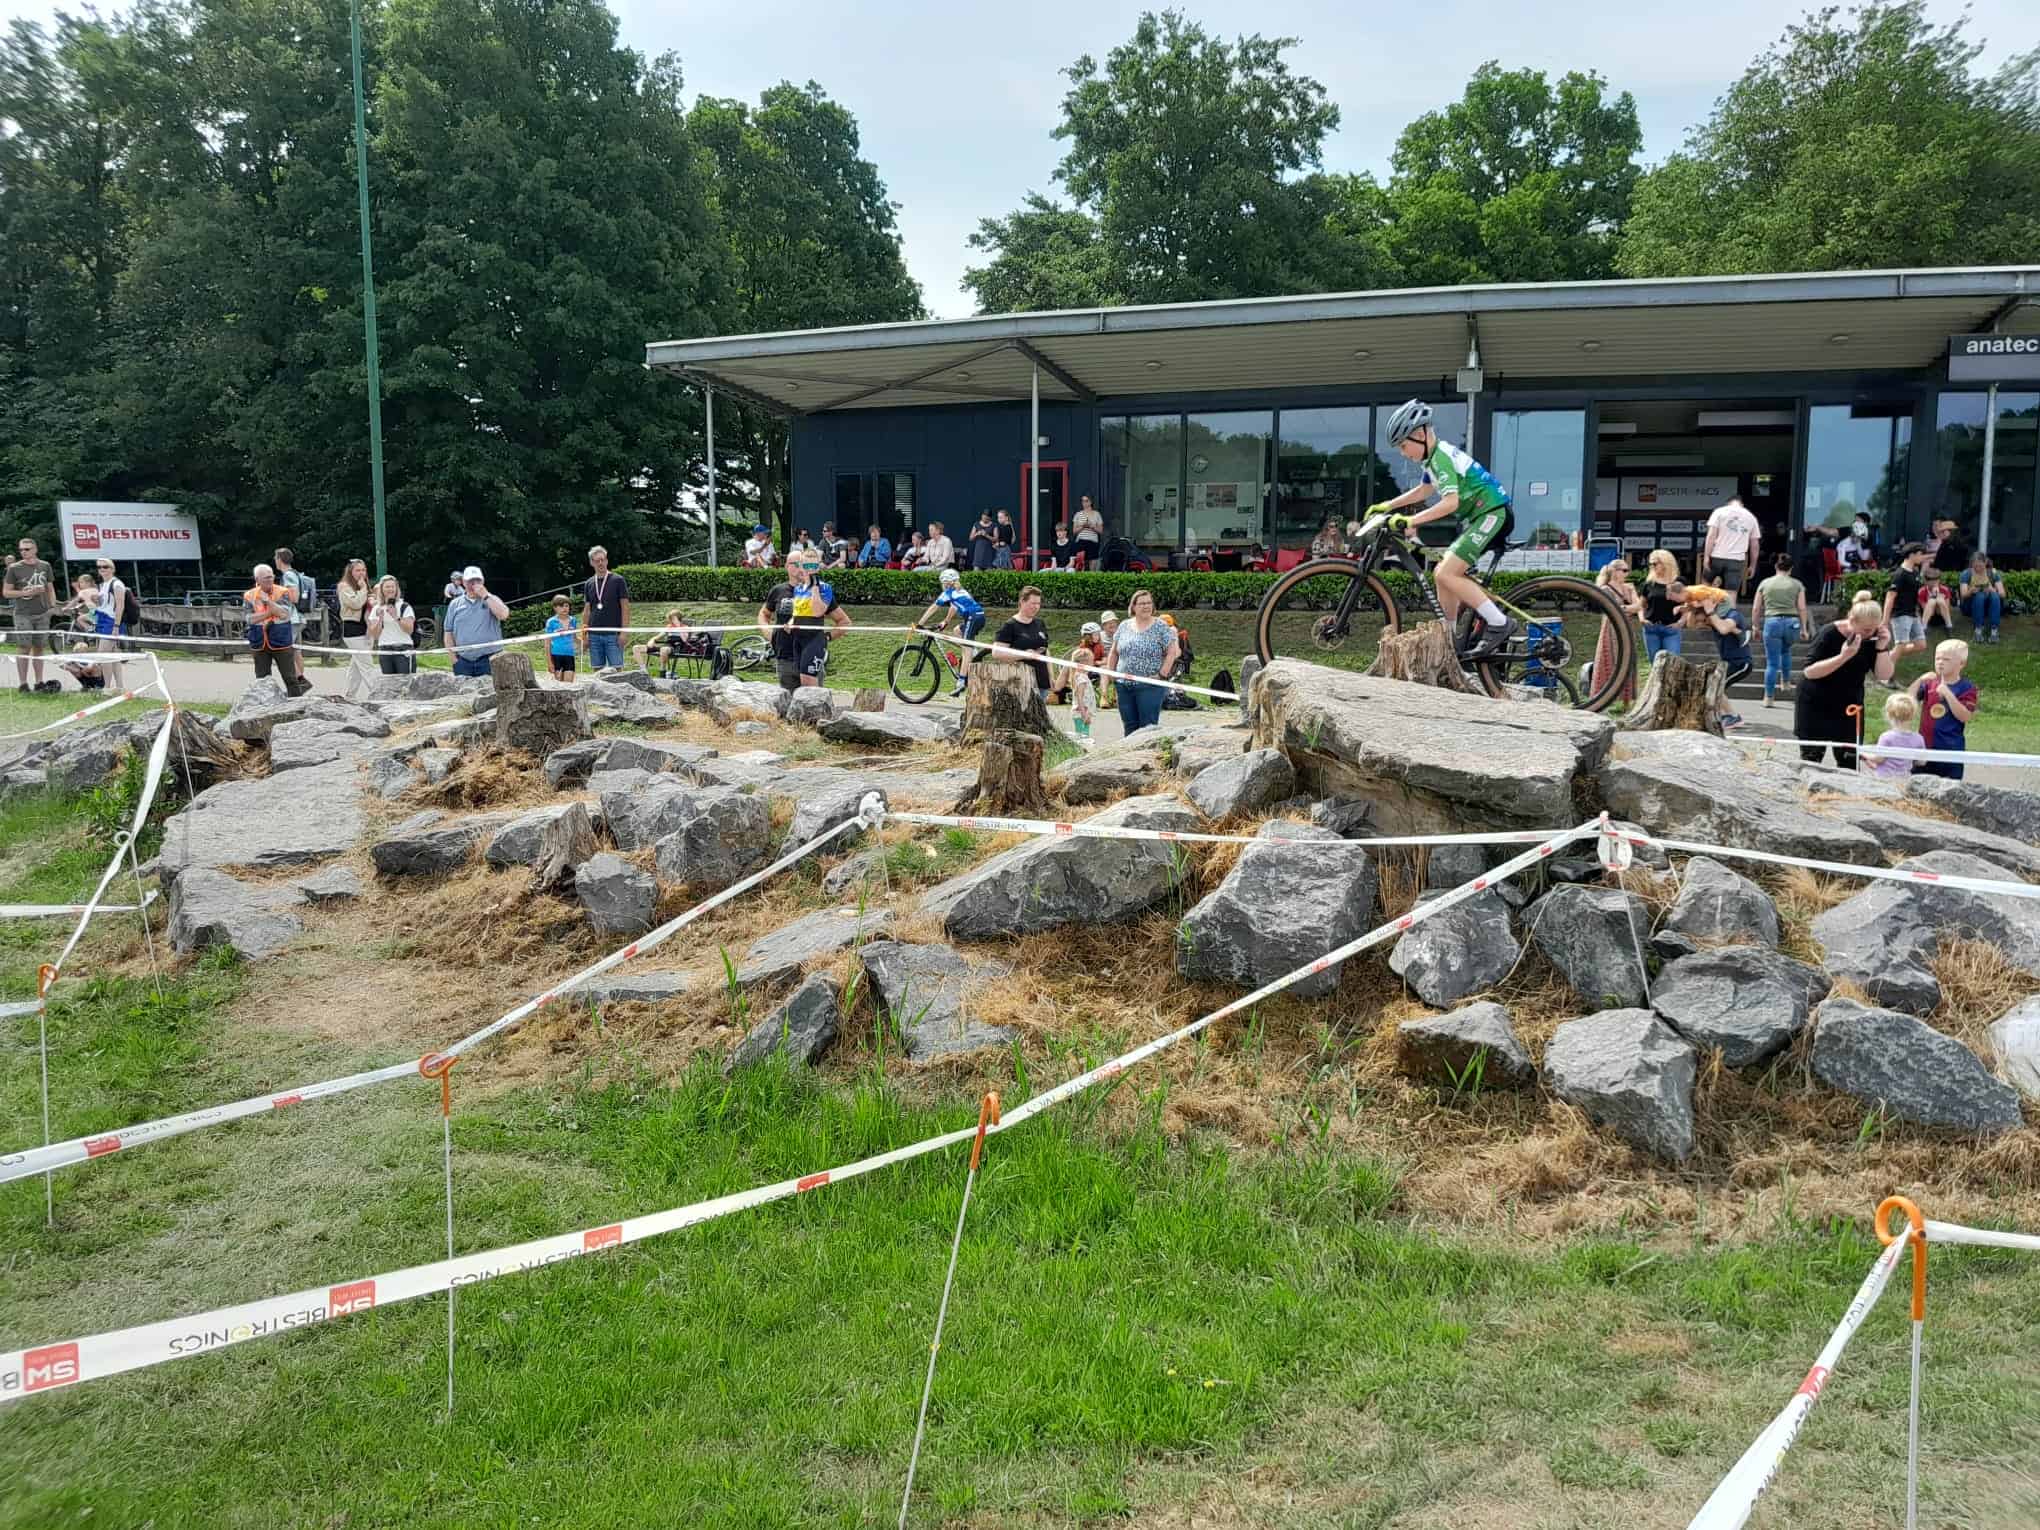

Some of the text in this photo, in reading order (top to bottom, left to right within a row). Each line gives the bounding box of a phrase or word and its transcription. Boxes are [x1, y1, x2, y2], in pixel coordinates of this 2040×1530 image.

[1966, 336, 2039, 353] anatec
[75, 528, 191, 540] SW BESTRONICS
[27, 1359, 76, 1384] SW
